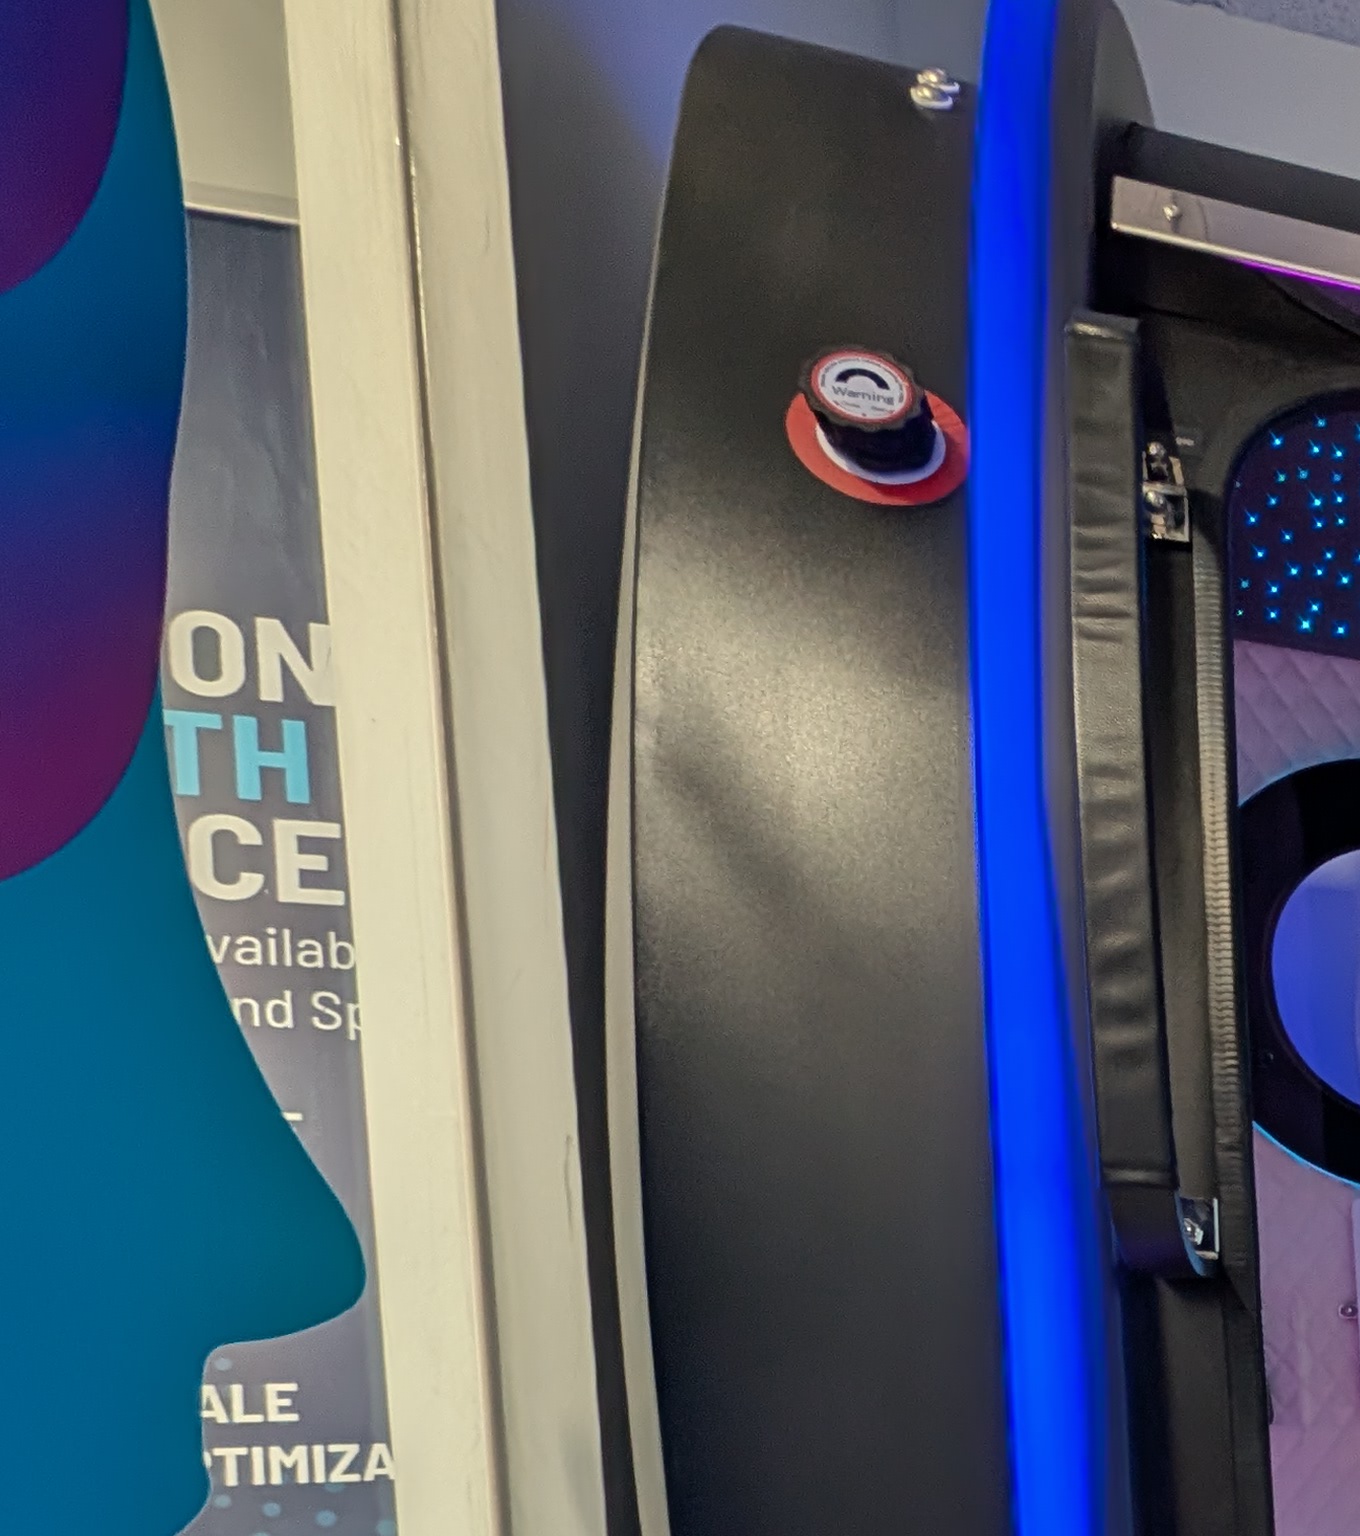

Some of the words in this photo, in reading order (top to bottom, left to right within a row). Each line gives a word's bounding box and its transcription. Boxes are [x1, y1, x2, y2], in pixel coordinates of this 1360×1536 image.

[831, 385, 895, 406] Warning
[162, 708, 310, 804] TH
[187, 813, 345, 906] CE
[200, 1383, 299, 1424] ALE
[203, 1443, 396, 1487] TIMIZA
